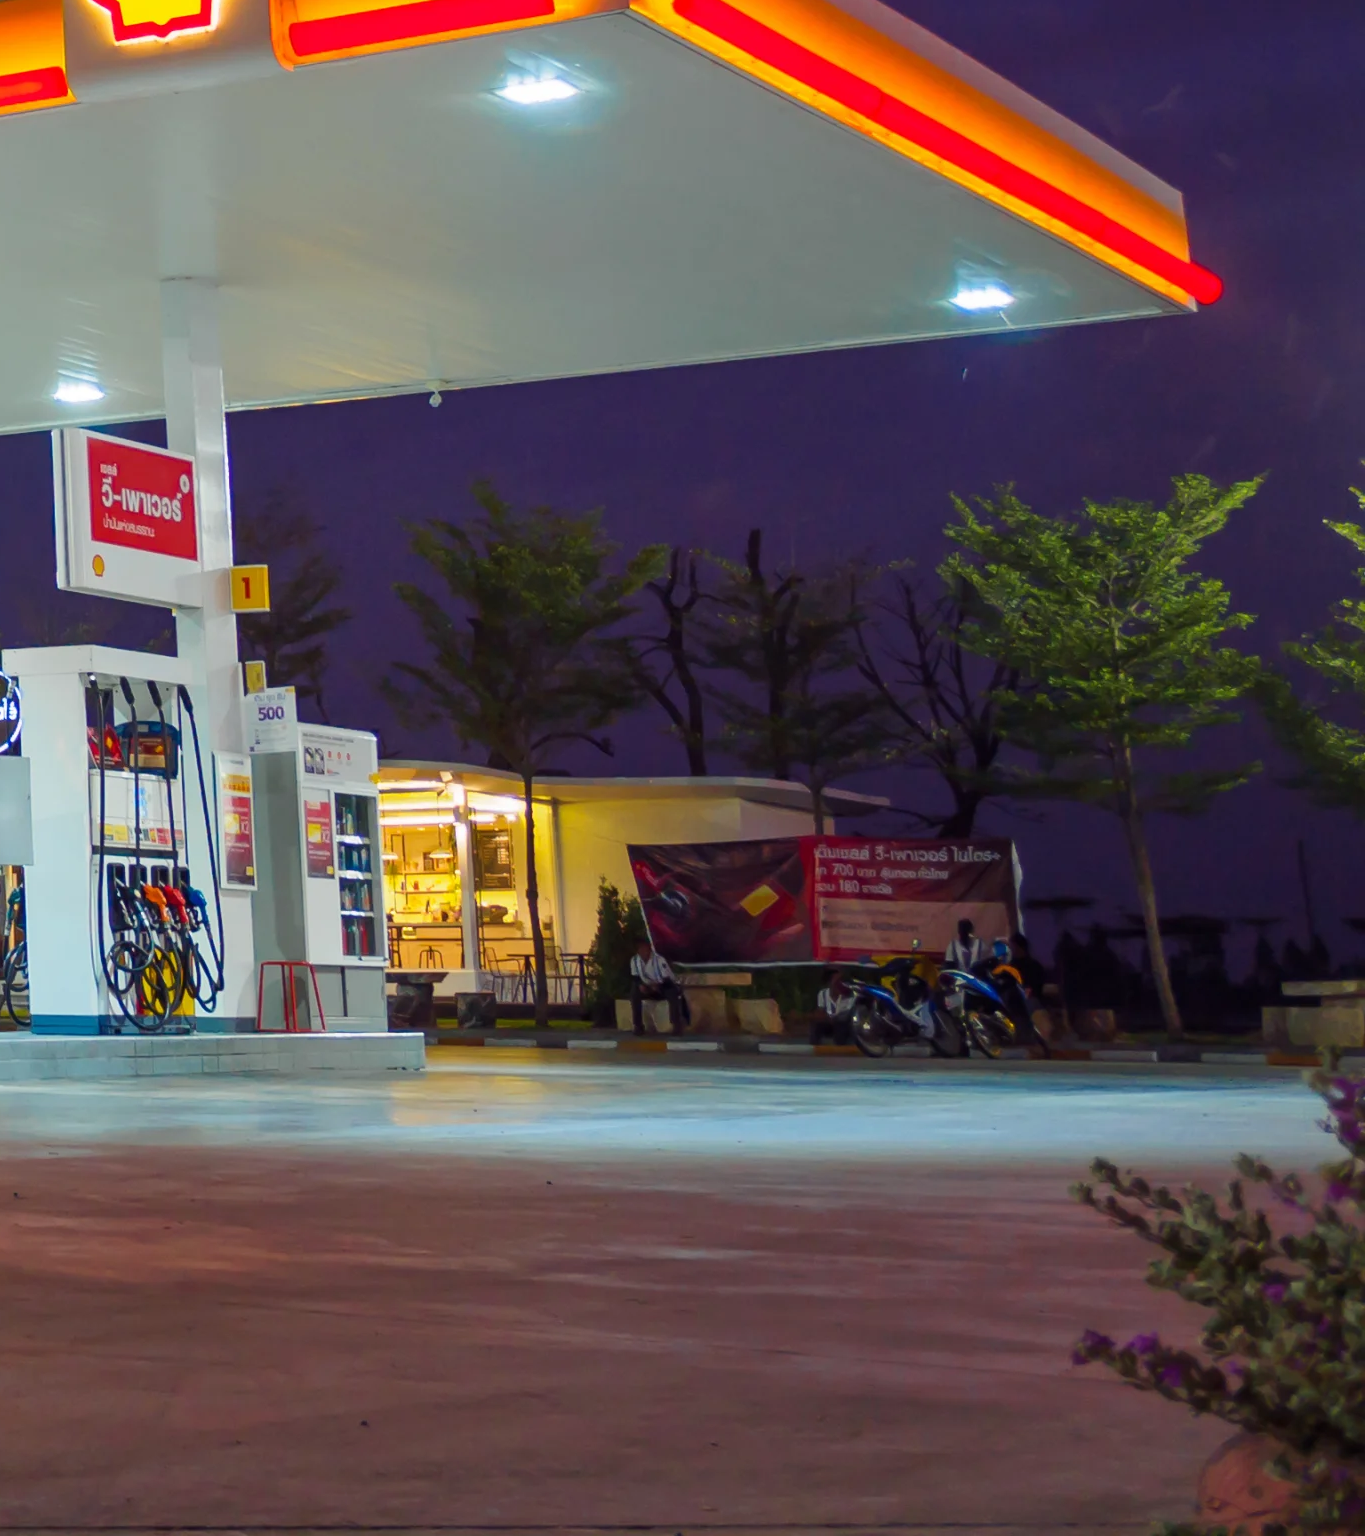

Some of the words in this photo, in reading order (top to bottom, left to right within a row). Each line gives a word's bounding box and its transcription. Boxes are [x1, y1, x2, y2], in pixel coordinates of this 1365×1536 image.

[101, 476, 183, 522] วี-เพาเวอร์
[241, 576, 251, 599] 1
[258, 706, 285, 721] 500
[832, 864, 853, 876] 700
